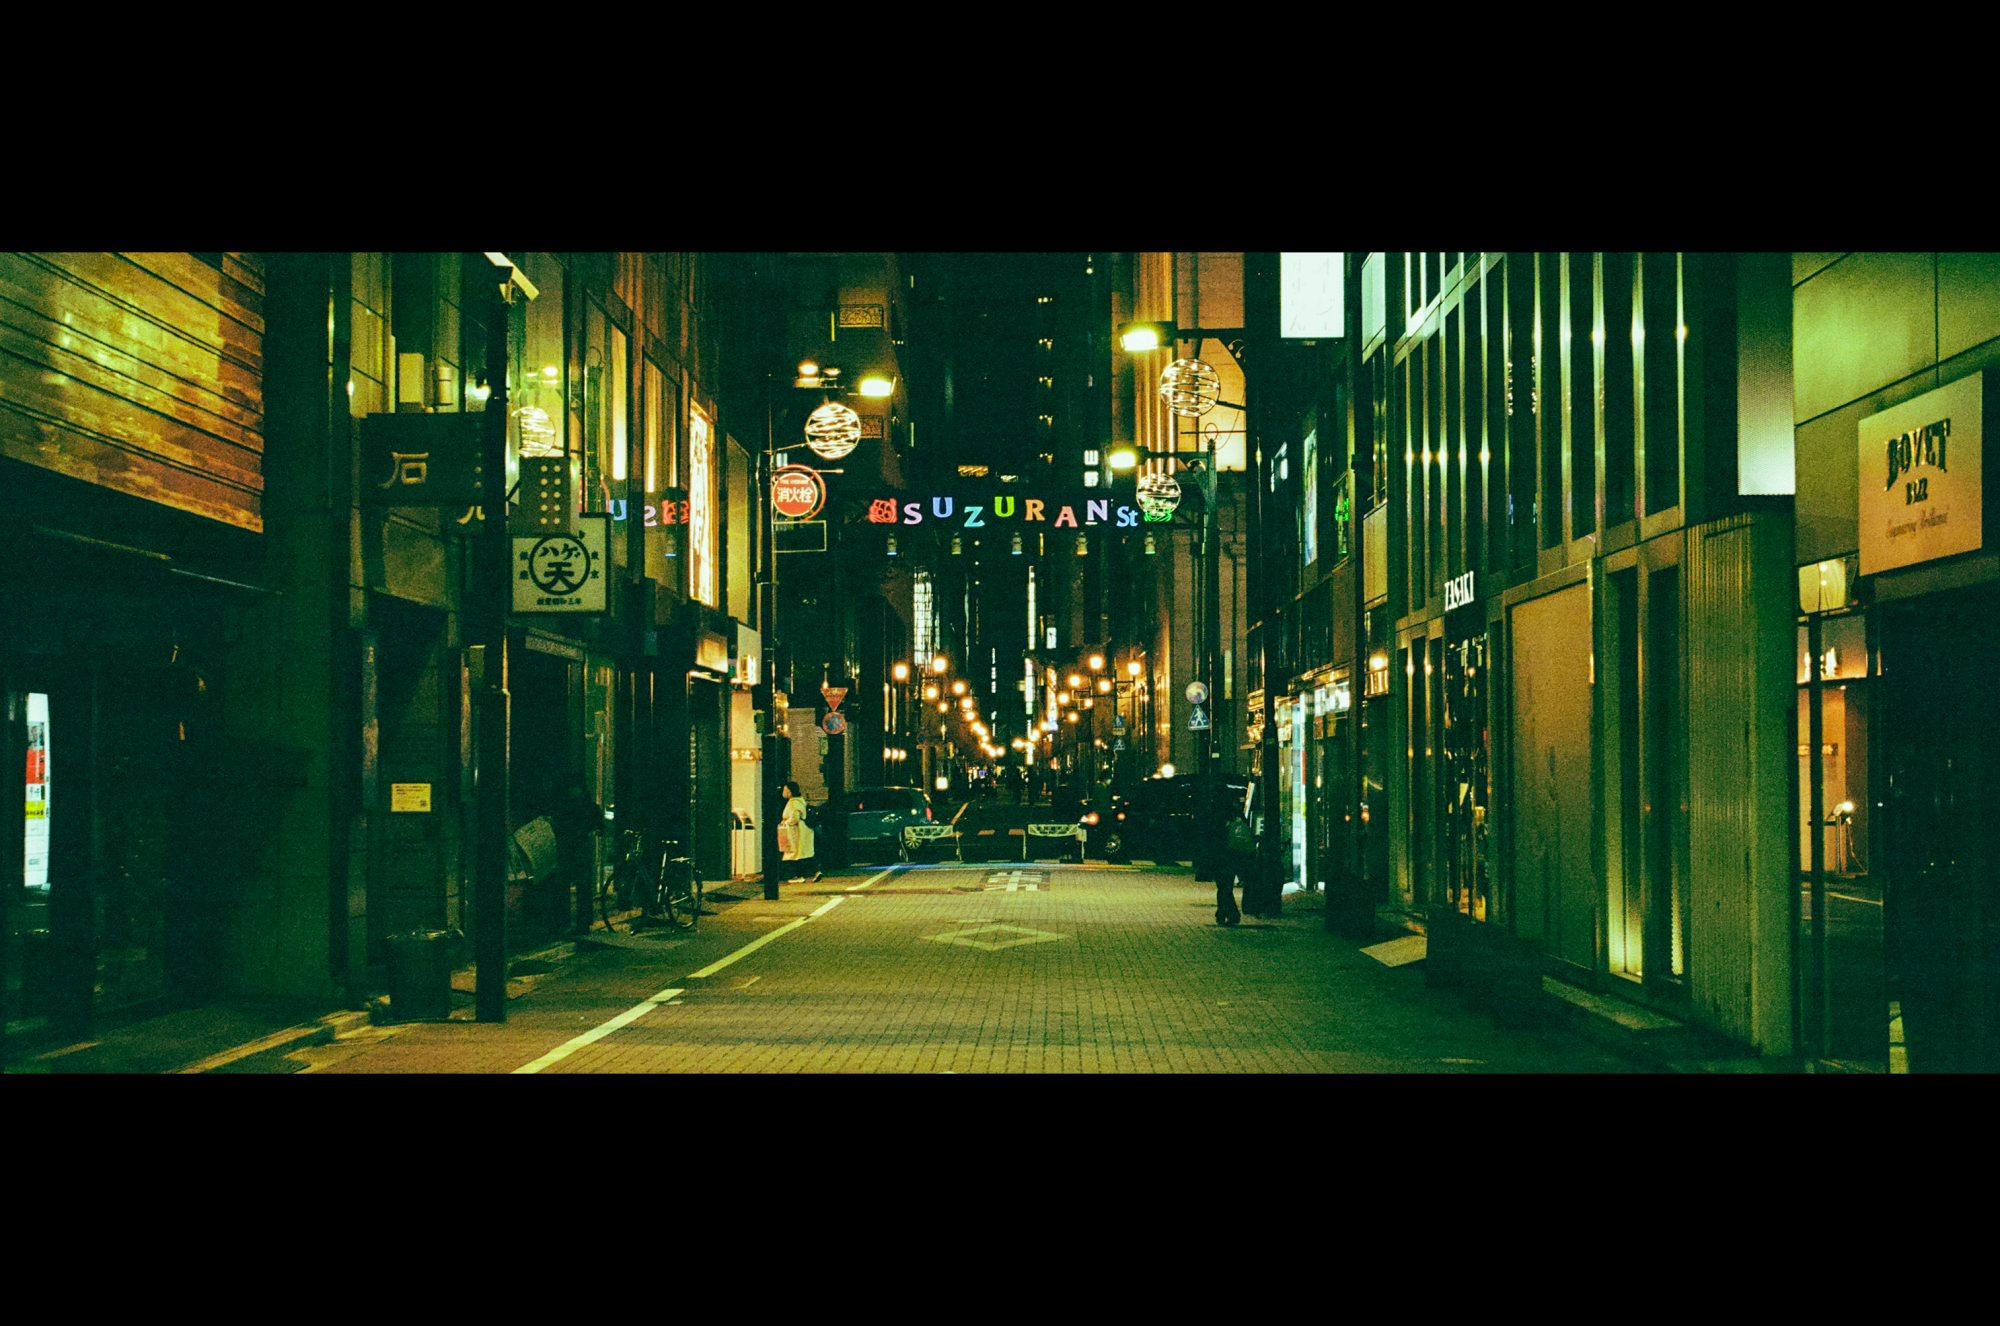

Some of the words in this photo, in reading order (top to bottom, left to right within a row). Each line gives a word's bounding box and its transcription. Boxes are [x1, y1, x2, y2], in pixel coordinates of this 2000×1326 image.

[378, 451, 430, 489] 石
[1884, 417, 1951, 491] BOVET
[776, 486, 813, 503] 消火栓
[903, 496, 1108, 528] SUZURAN
[1116, 505, 1138, 527] St
[1444, 570, 1474, 611] TASAKI
